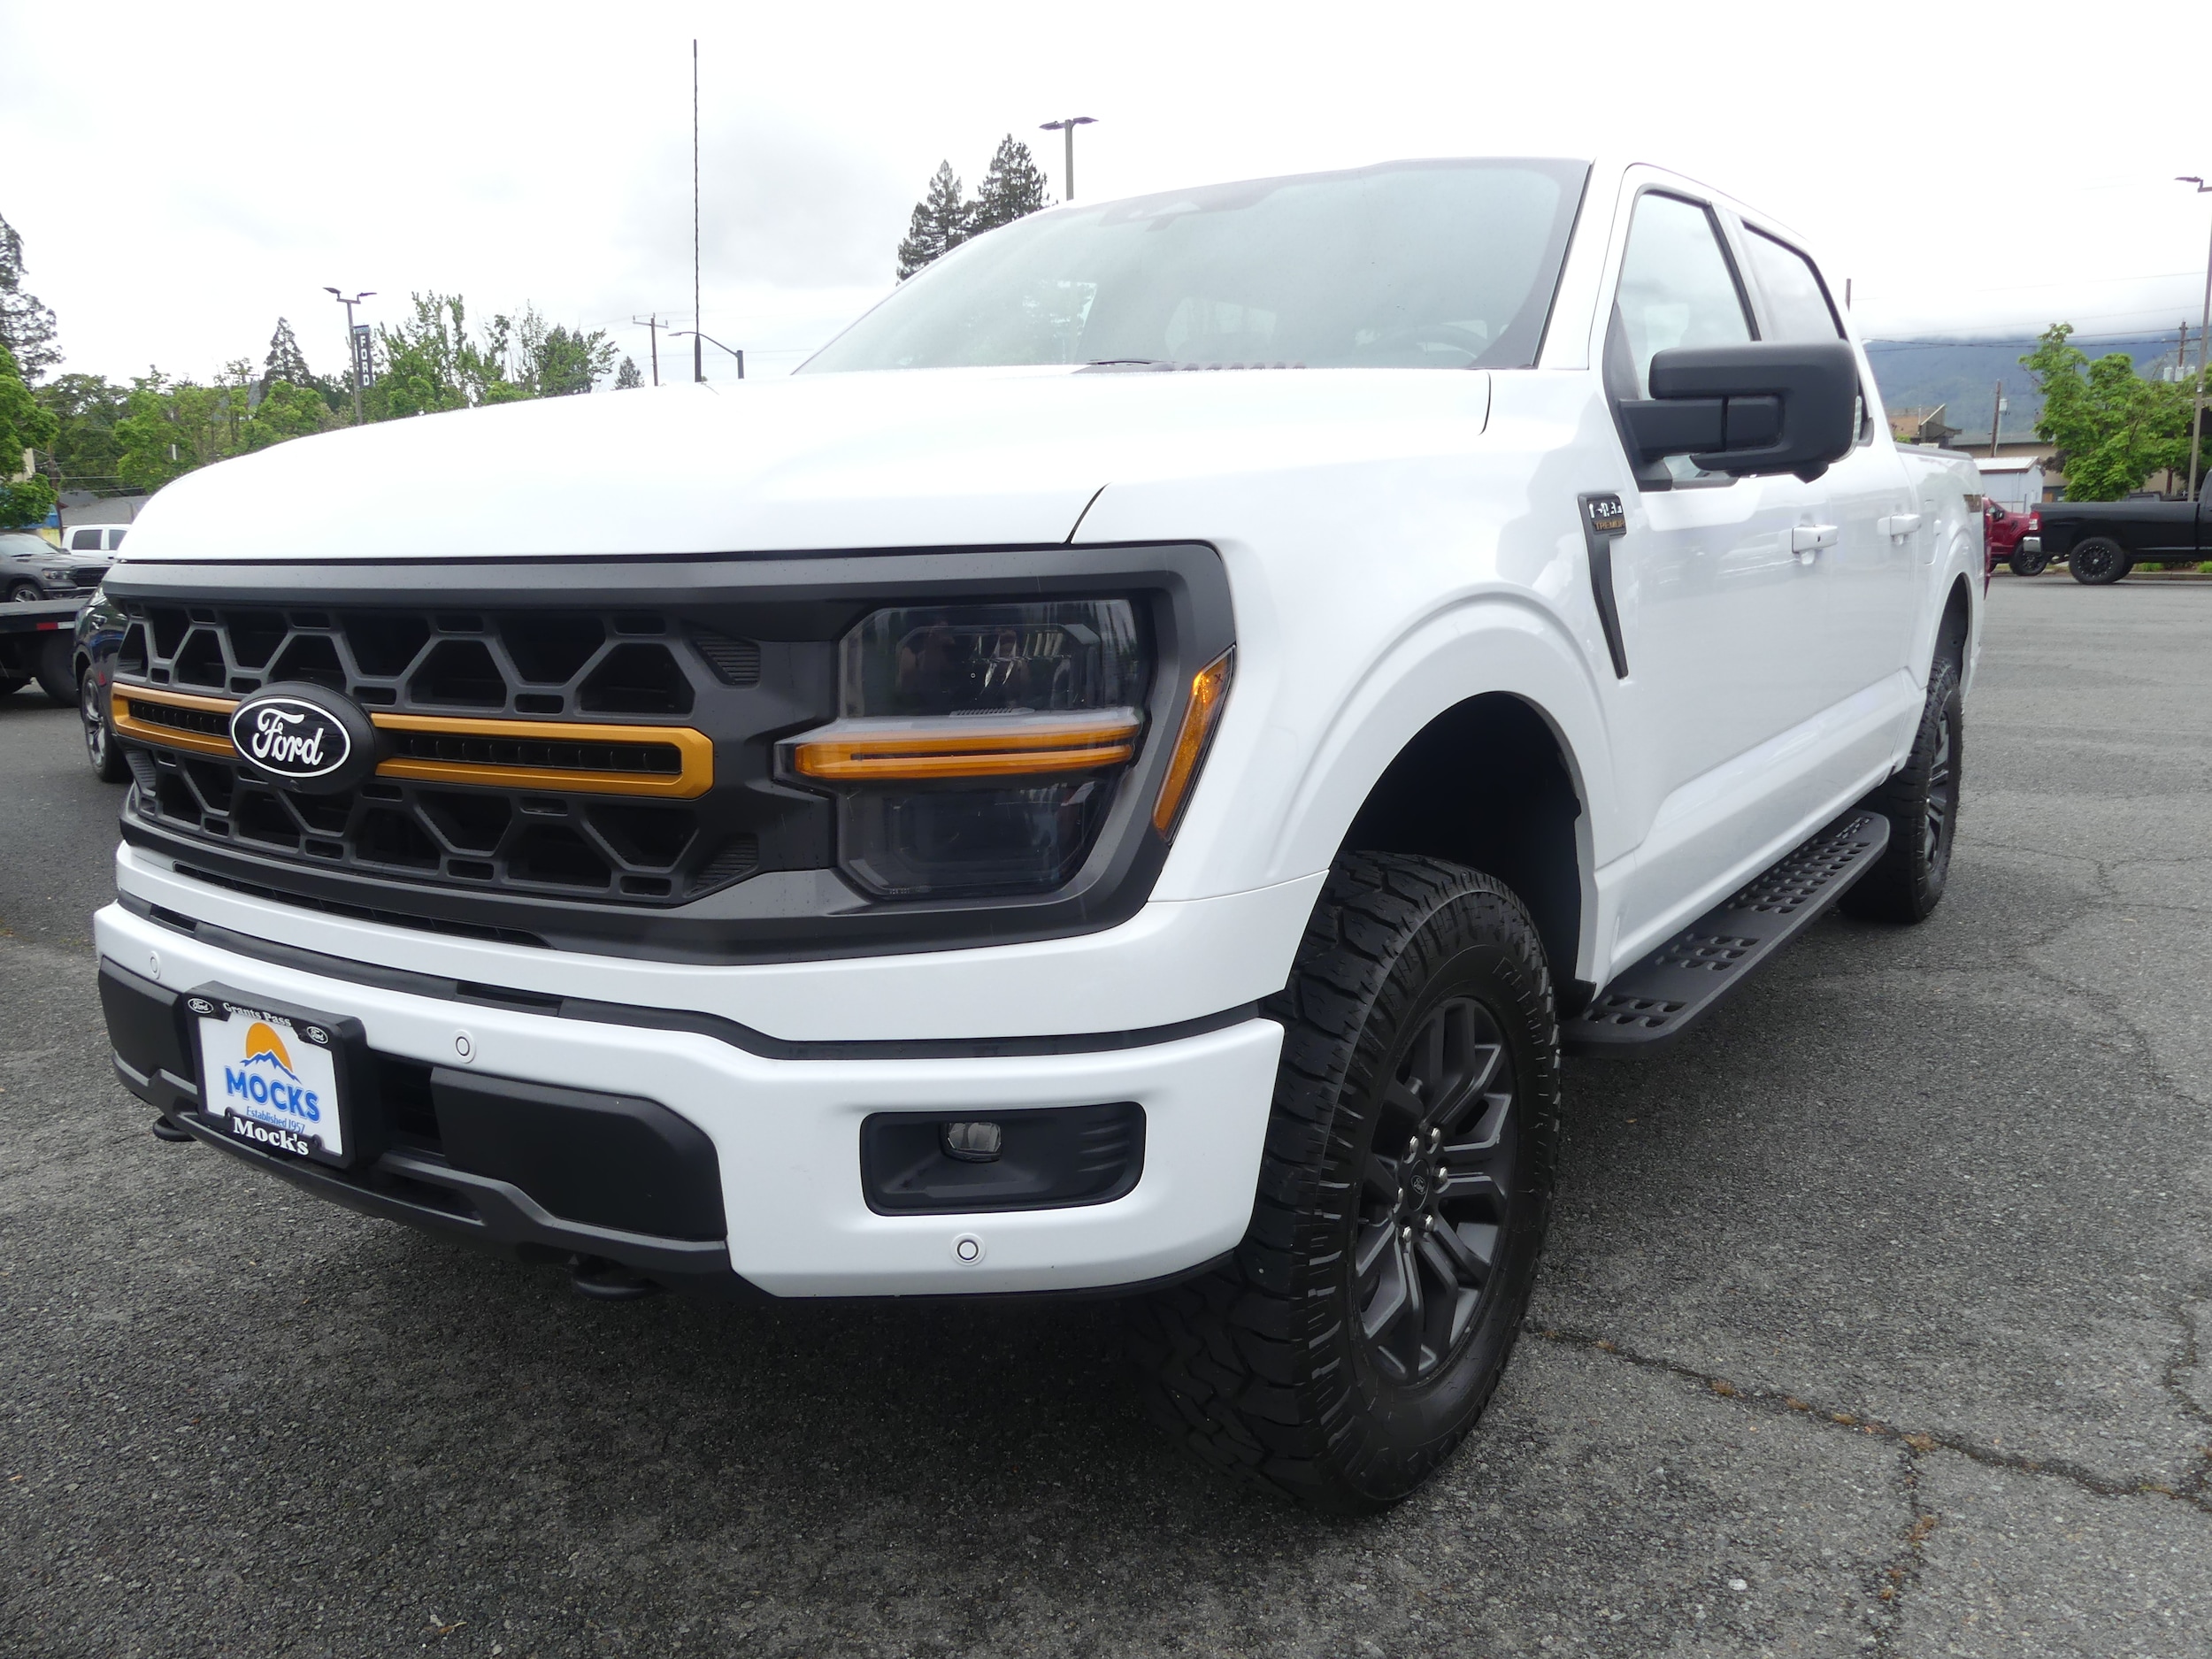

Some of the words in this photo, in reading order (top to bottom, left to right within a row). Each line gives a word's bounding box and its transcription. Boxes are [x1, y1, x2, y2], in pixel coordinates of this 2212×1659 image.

[360, 335, 370, 386] FORD
[252, 708, 324, 766] Ford
[223, 1002, 262, 1019] Grants
[263, 1011, 292, 1027] Pass
[225, 1066, 320, 1123] MOCKS
[233, 1117, 310, 1156] Mock's
[246, 1107, 287, 1127] Established
[288, 1118, 306, 1134] 1957
